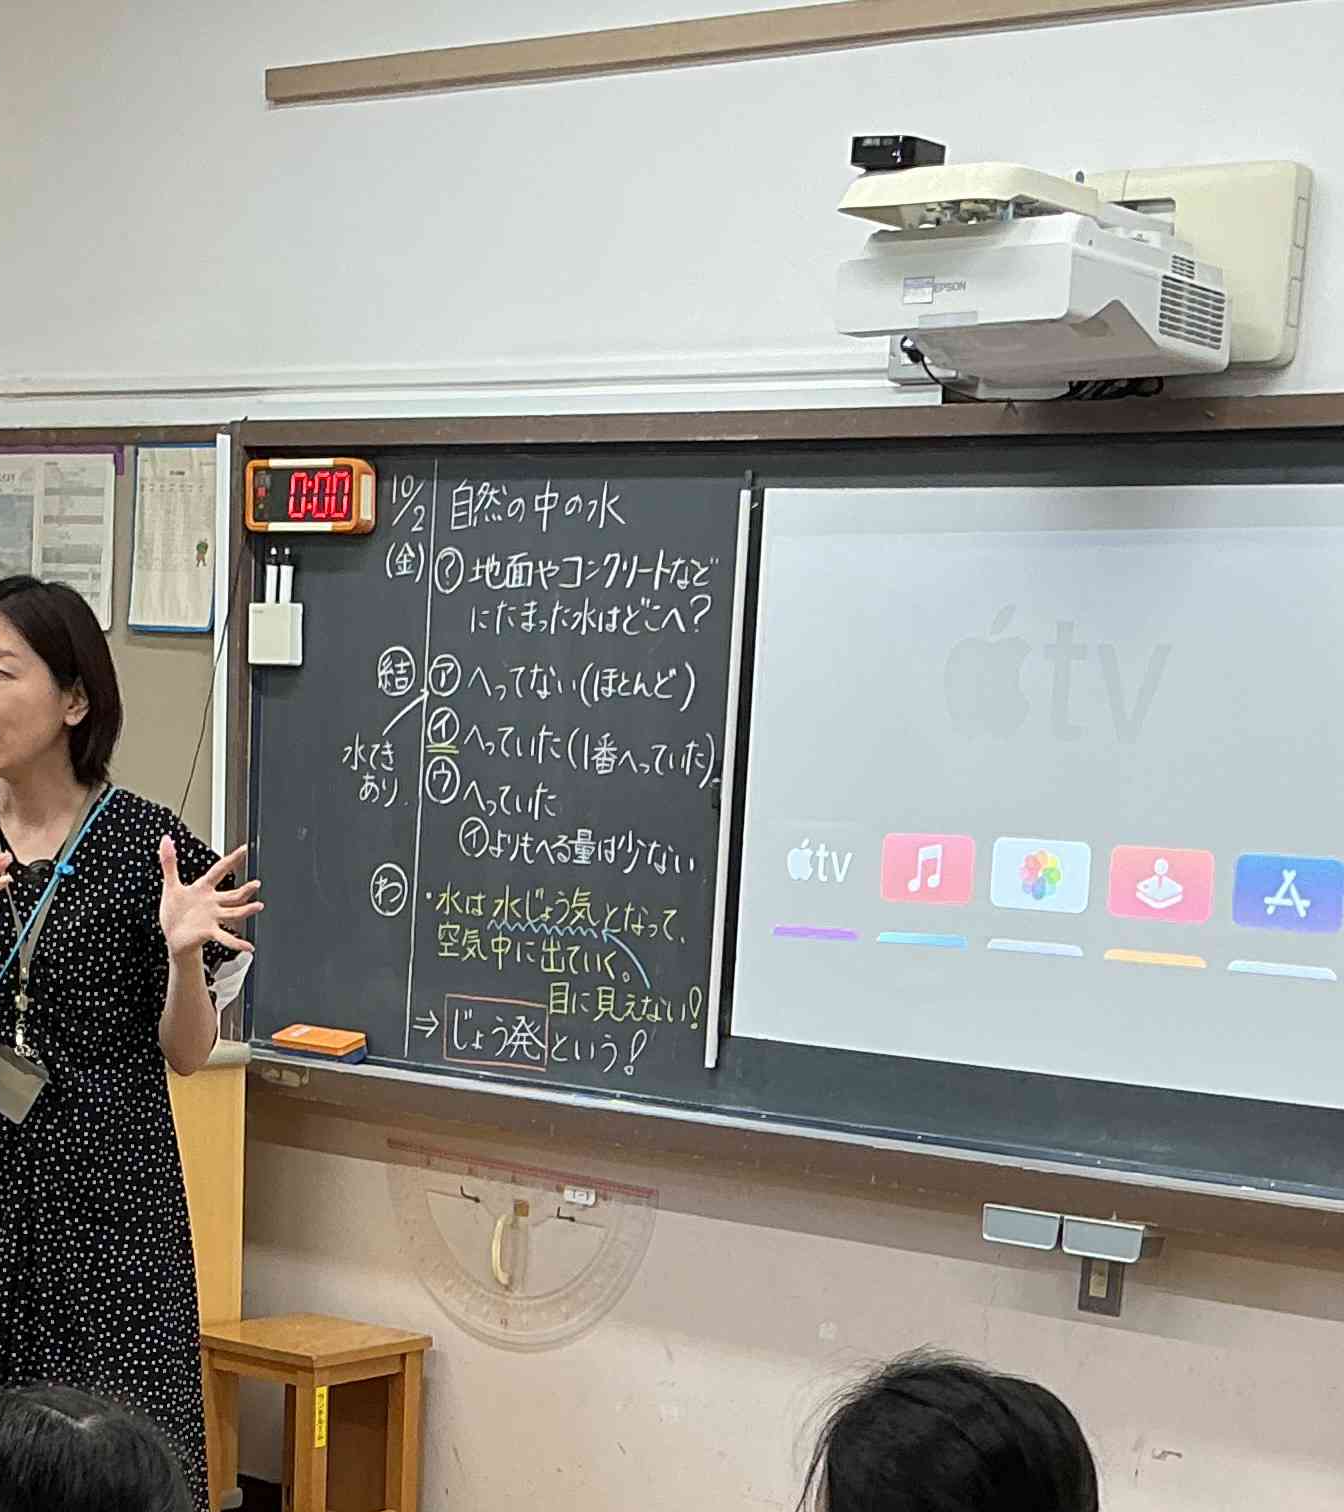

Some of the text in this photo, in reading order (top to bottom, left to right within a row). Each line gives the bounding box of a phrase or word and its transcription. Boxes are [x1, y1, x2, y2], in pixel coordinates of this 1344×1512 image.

[288, 471, 350, 518] 0:00
[451, 478, 626, 533] 自然の中の水
[471, 594, 713, 635] にたまった水はどこへ？
[342, 731, 395, 771] 水てき
[437, 919, 632, 984] 空気中に出ていく。
